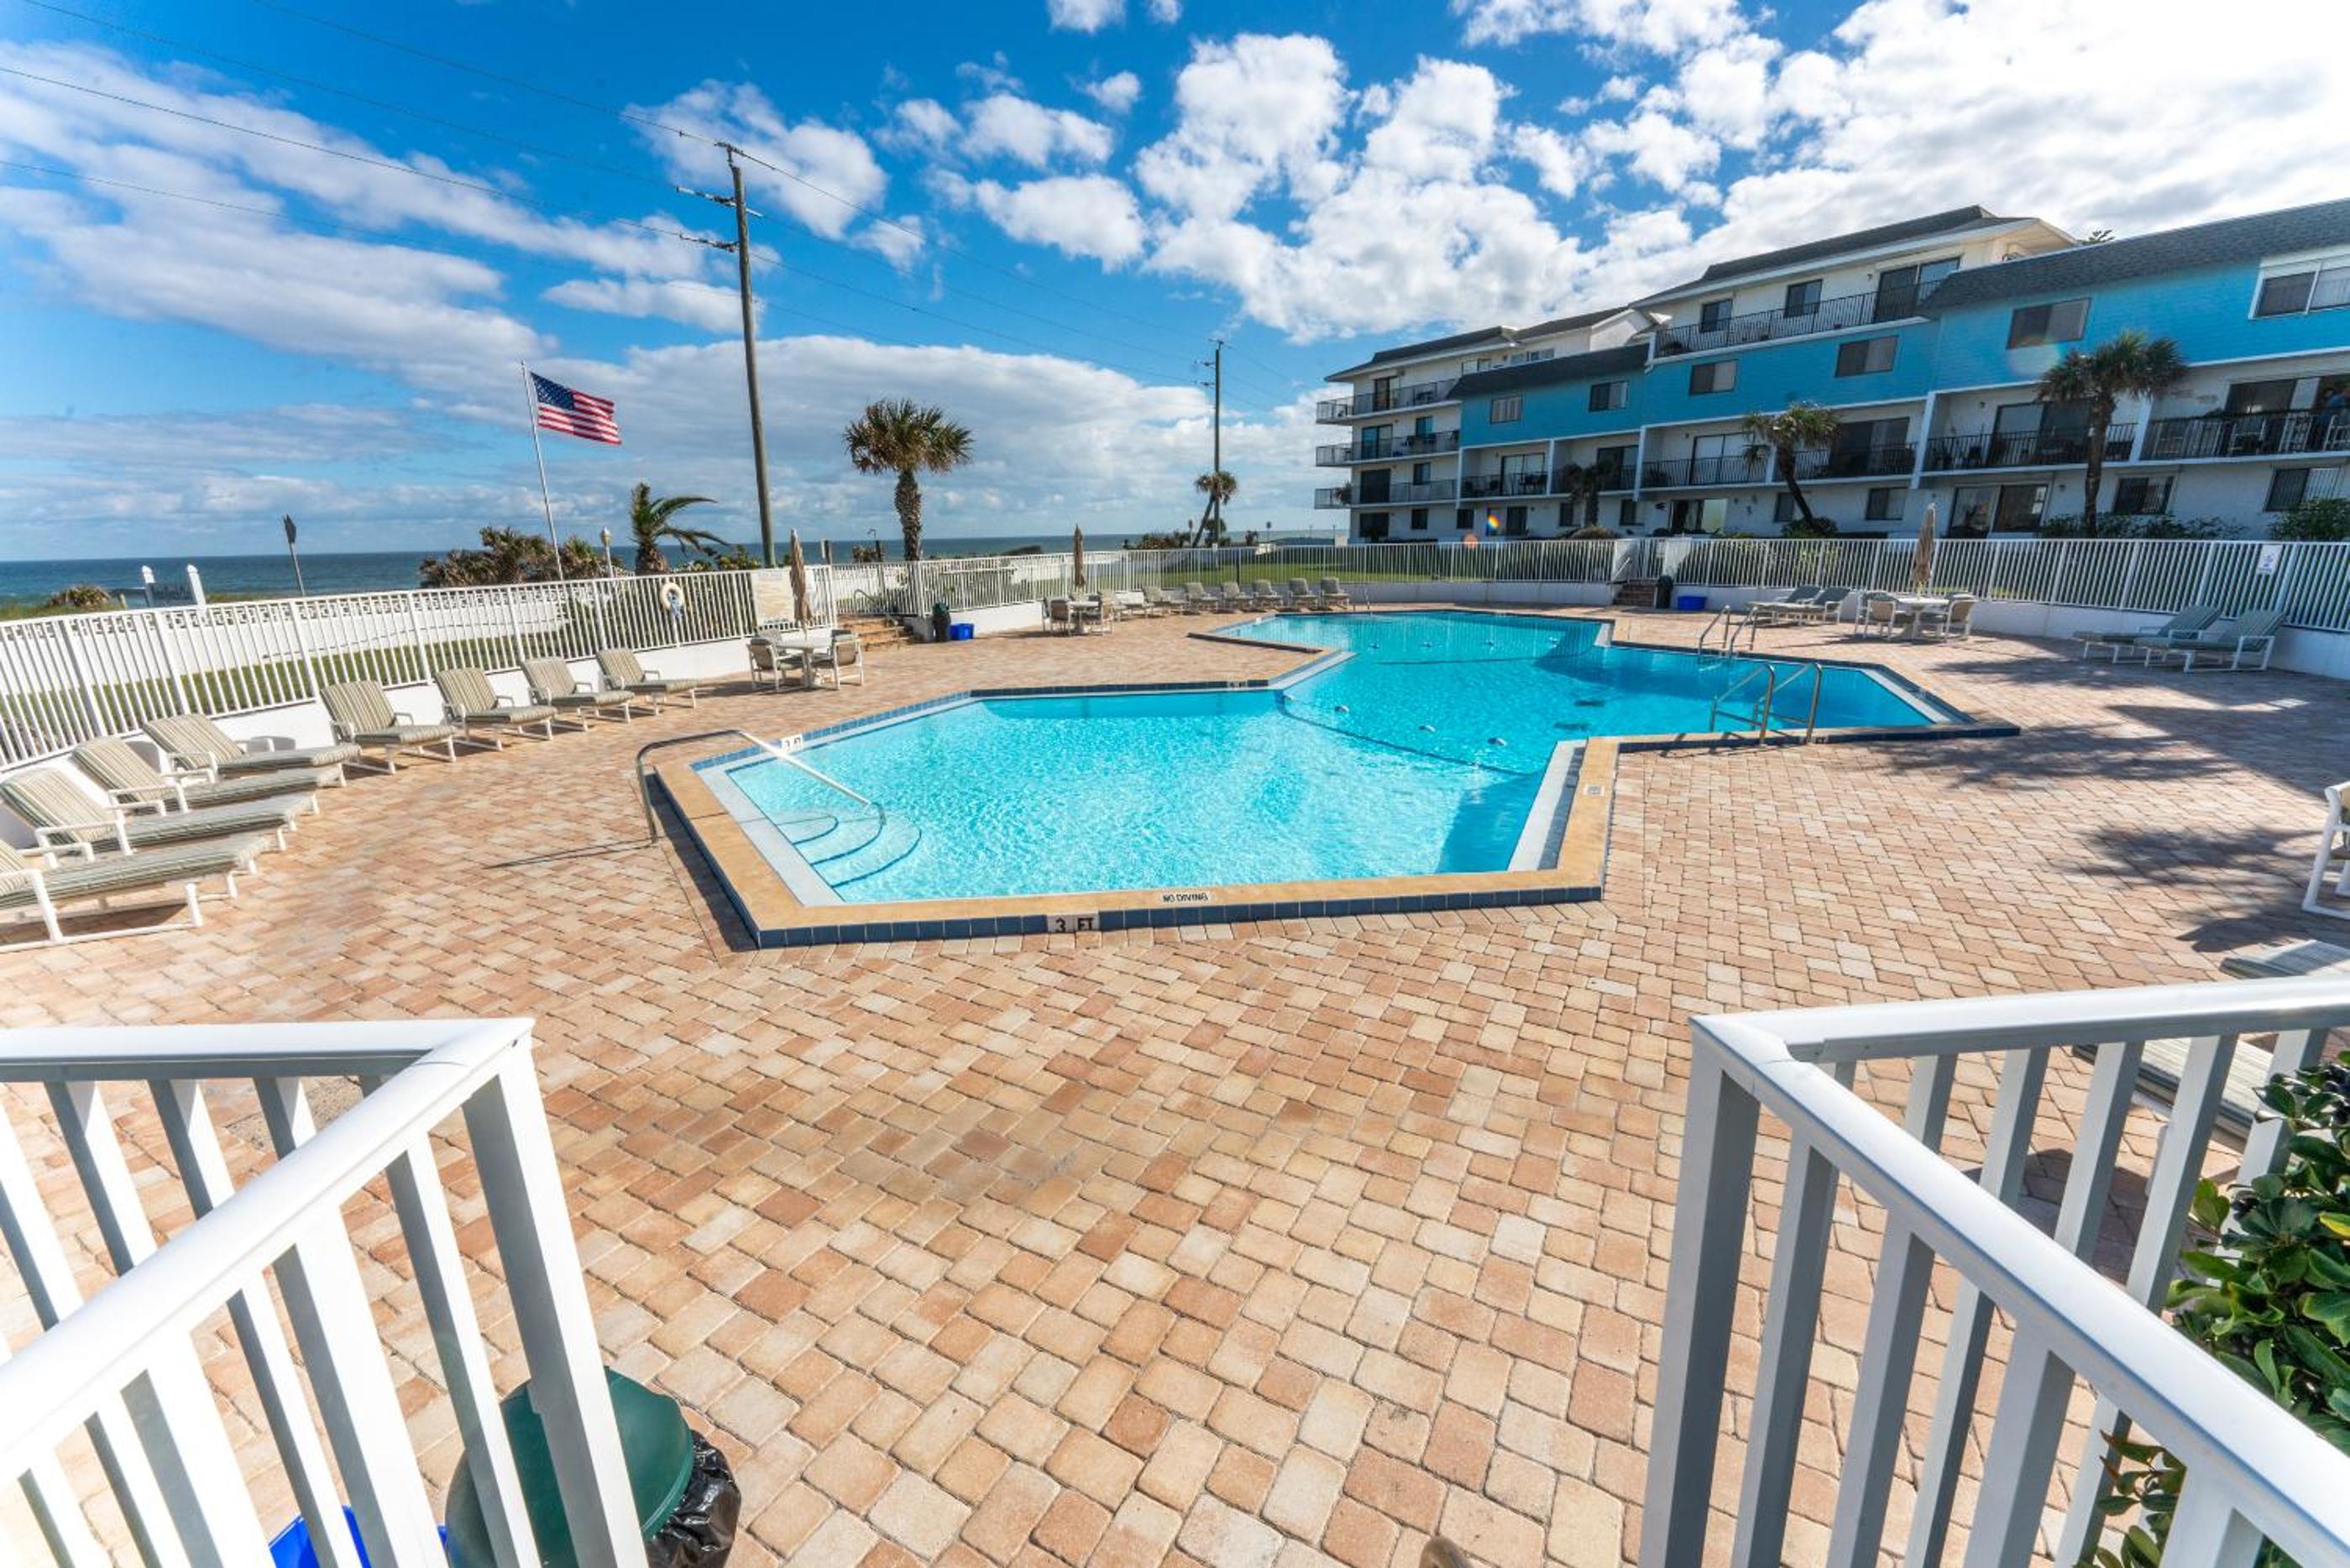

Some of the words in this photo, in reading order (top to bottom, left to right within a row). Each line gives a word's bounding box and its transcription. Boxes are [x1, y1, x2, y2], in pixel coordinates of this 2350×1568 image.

[1163, 893, 1175, 903] NO
[1176, 892, 1209, 902] DIVING
[1055, 917, 1066, 933] 3
[1077, 917, 1094, 931] FT
